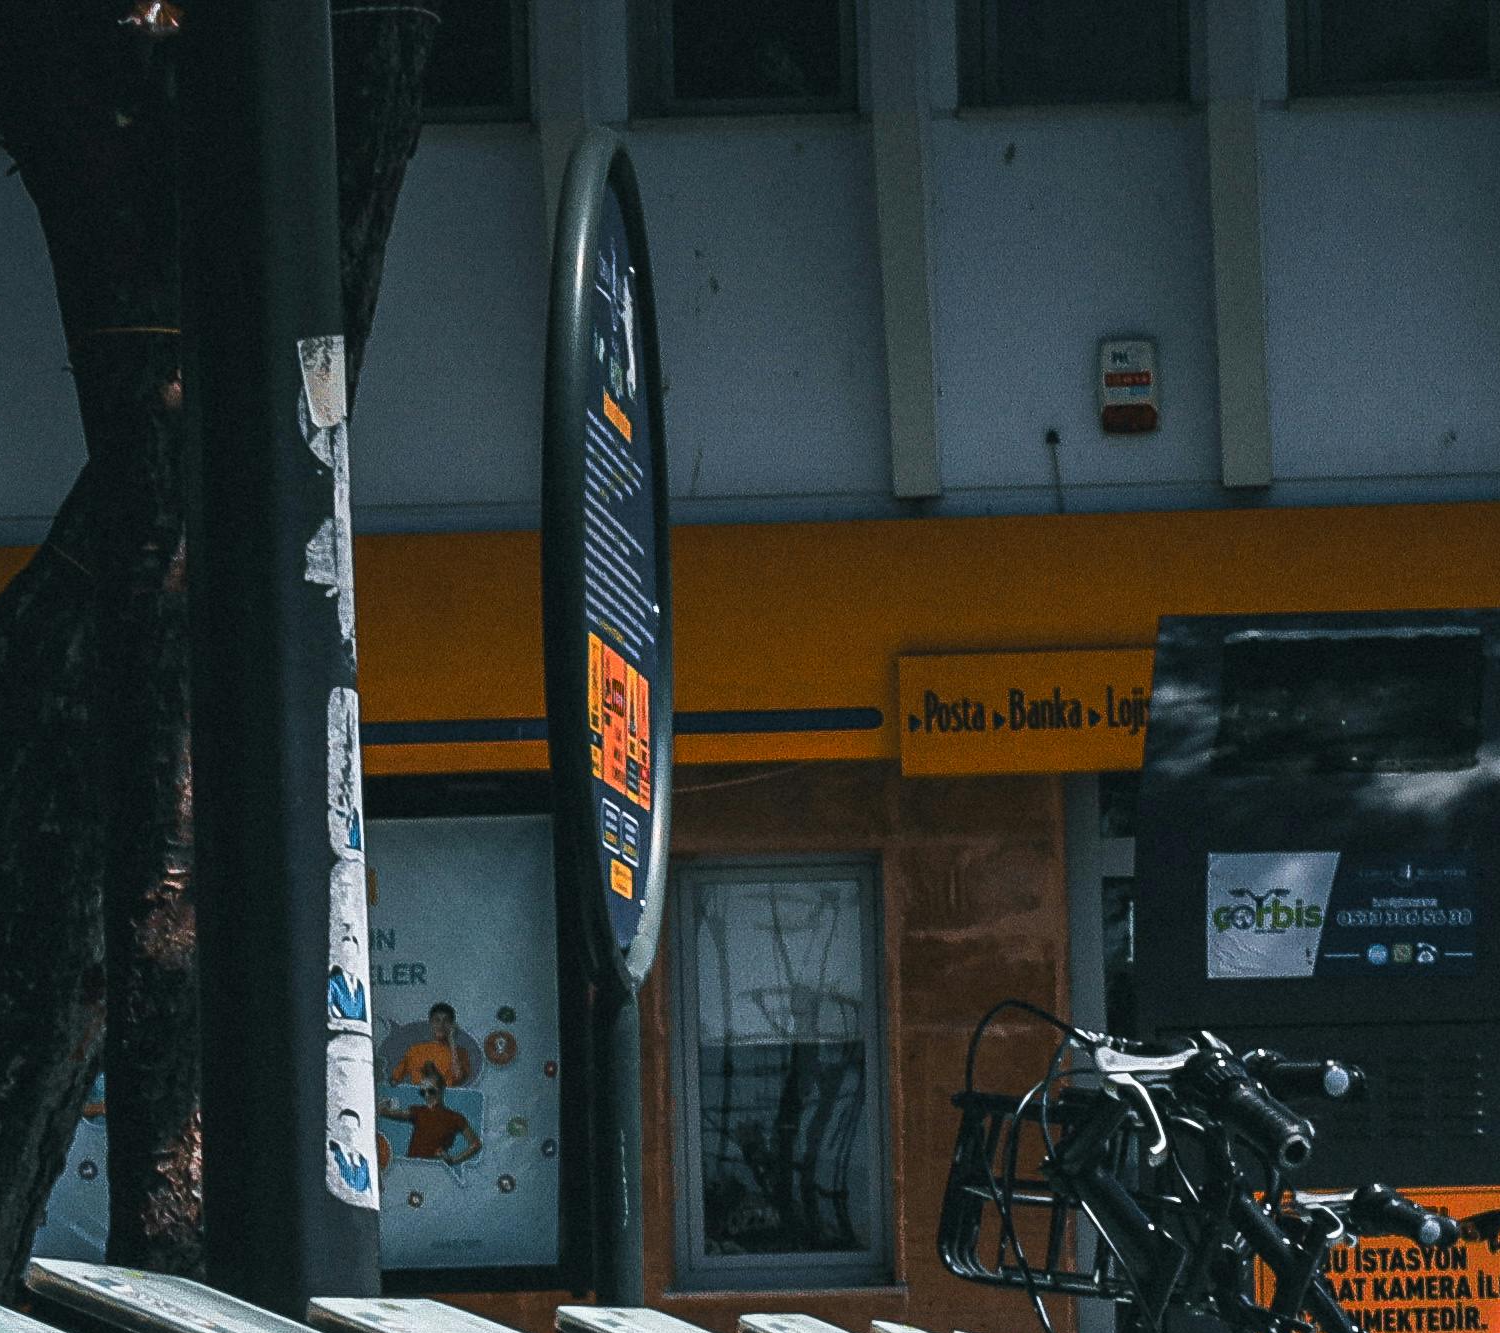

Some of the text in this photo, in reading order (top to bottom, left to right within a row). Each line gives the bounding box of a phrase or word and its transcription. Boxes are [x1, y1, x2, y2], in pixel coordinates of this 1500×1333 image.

[924, 688, 987, 733] Posta
[1008, 686, 1083, 731] Banka
[1373, 1275, 1473, 1301] KAMERA
